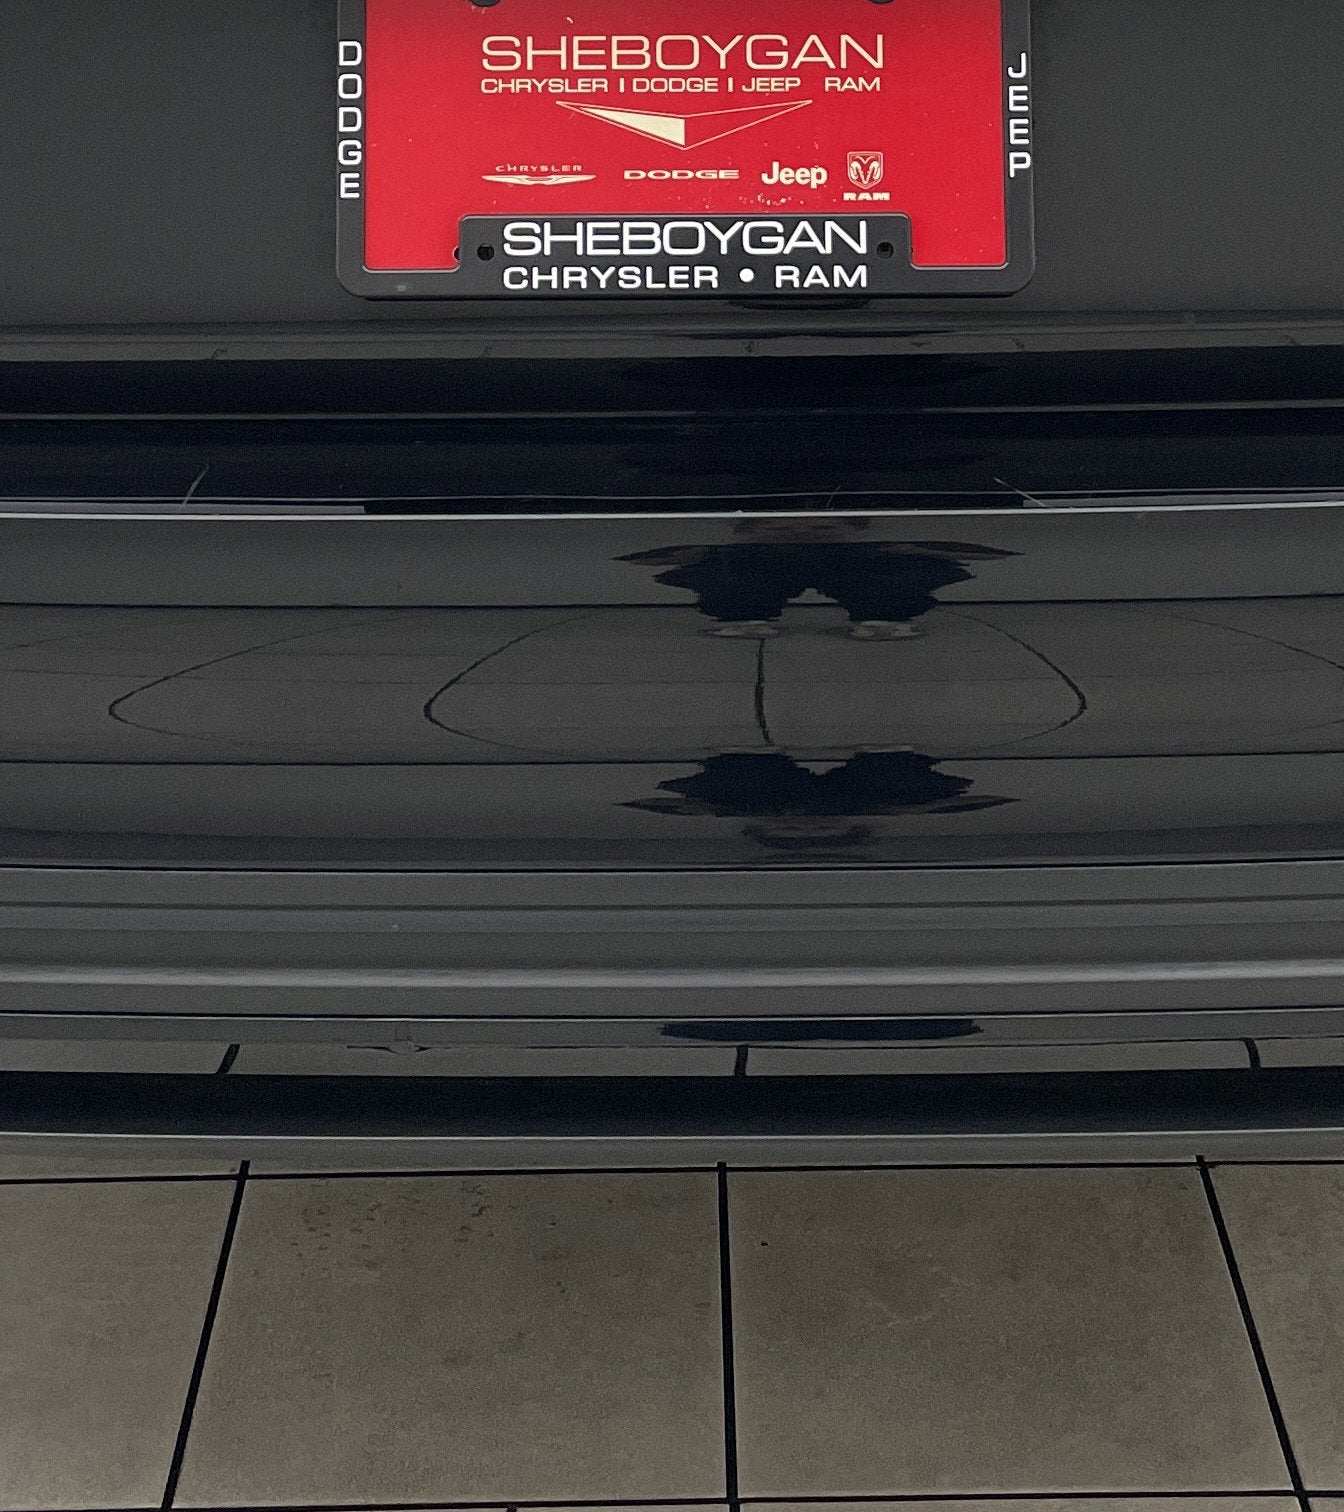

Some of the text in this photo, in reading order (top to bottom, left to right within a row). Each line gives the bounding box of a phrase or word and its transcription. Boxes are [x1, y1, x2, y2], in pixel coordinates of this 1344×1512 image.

[481, 33, 884, 71] SHEBOYGAN
[480, 76, 881, 94] CHRYSLER DODGE JEEP RAM
[338, 41, 362, 199] DODGE
[1008, 53, 1031, 178] JEEP
[495, 164, 582, 173] CHRYSLER
[623, 169, 740, 181] DODGE
[761, 161, 828, 190] Jeep
[843, 192, 891, 202] RAM
[502, 221, 868, 256] SHEBOYGAN
[503, 265, 868, 289] CHRYSLER RAM
